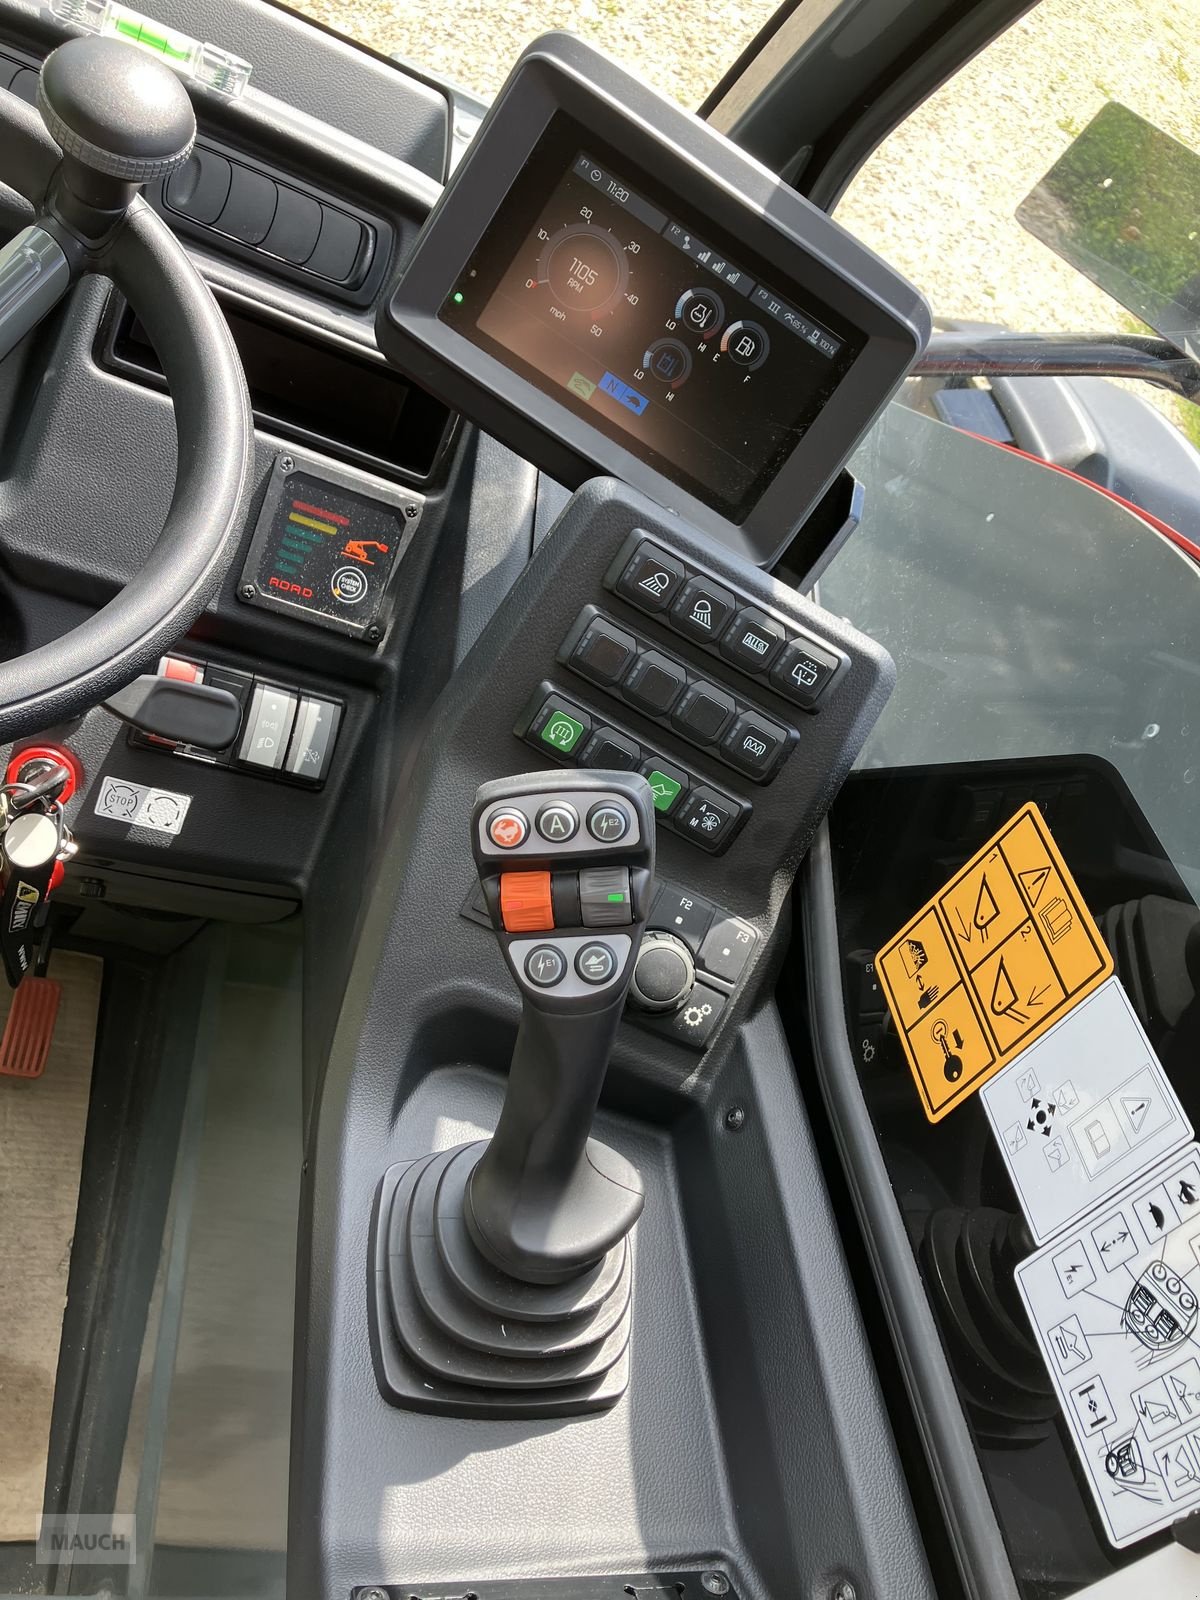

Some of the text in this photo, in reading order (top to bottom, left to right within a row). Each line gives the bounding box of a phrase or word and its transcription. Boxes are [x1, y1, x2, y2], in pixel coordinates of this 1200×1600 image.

[606, 180, 630, 203] 11:20
[580, 206, 593, 220] 20
[536, 228, 548, 241] 10
[628, 240, 641, 254] 30
[569, 257, 599, 286] 1105
[525, 279, 533, 289] 0
[566, 278, 584, 294] RPM
[626, 293, 639, 306] 40
[549, 306, 567, 321] mph
[590, 324, 602, 337] 50
[665, 318, 677, 331] LO
[697, 342, 707, 353] HI
[712, 353, 720, 362] E
[633, 368, 644, 380] LO
[743, 375, 751, 384] F
[607, 379, 618, 393] N
[665, 391, 675, 402] HI
[341, 576, 360, 588] SYSTEM
[745, 633, 760, 648] ALL
[108, 794, 134, 807] STOP
[699, 804, 707, 813] A
[550, 816, 565, 834] A
[608, 818, 620, 826] E2
[690, 818, 699, 827] M
[679, 898, 693, 910] F2
[736, 930, 748, 944] F3
[546, 960, 556, 968] E1
